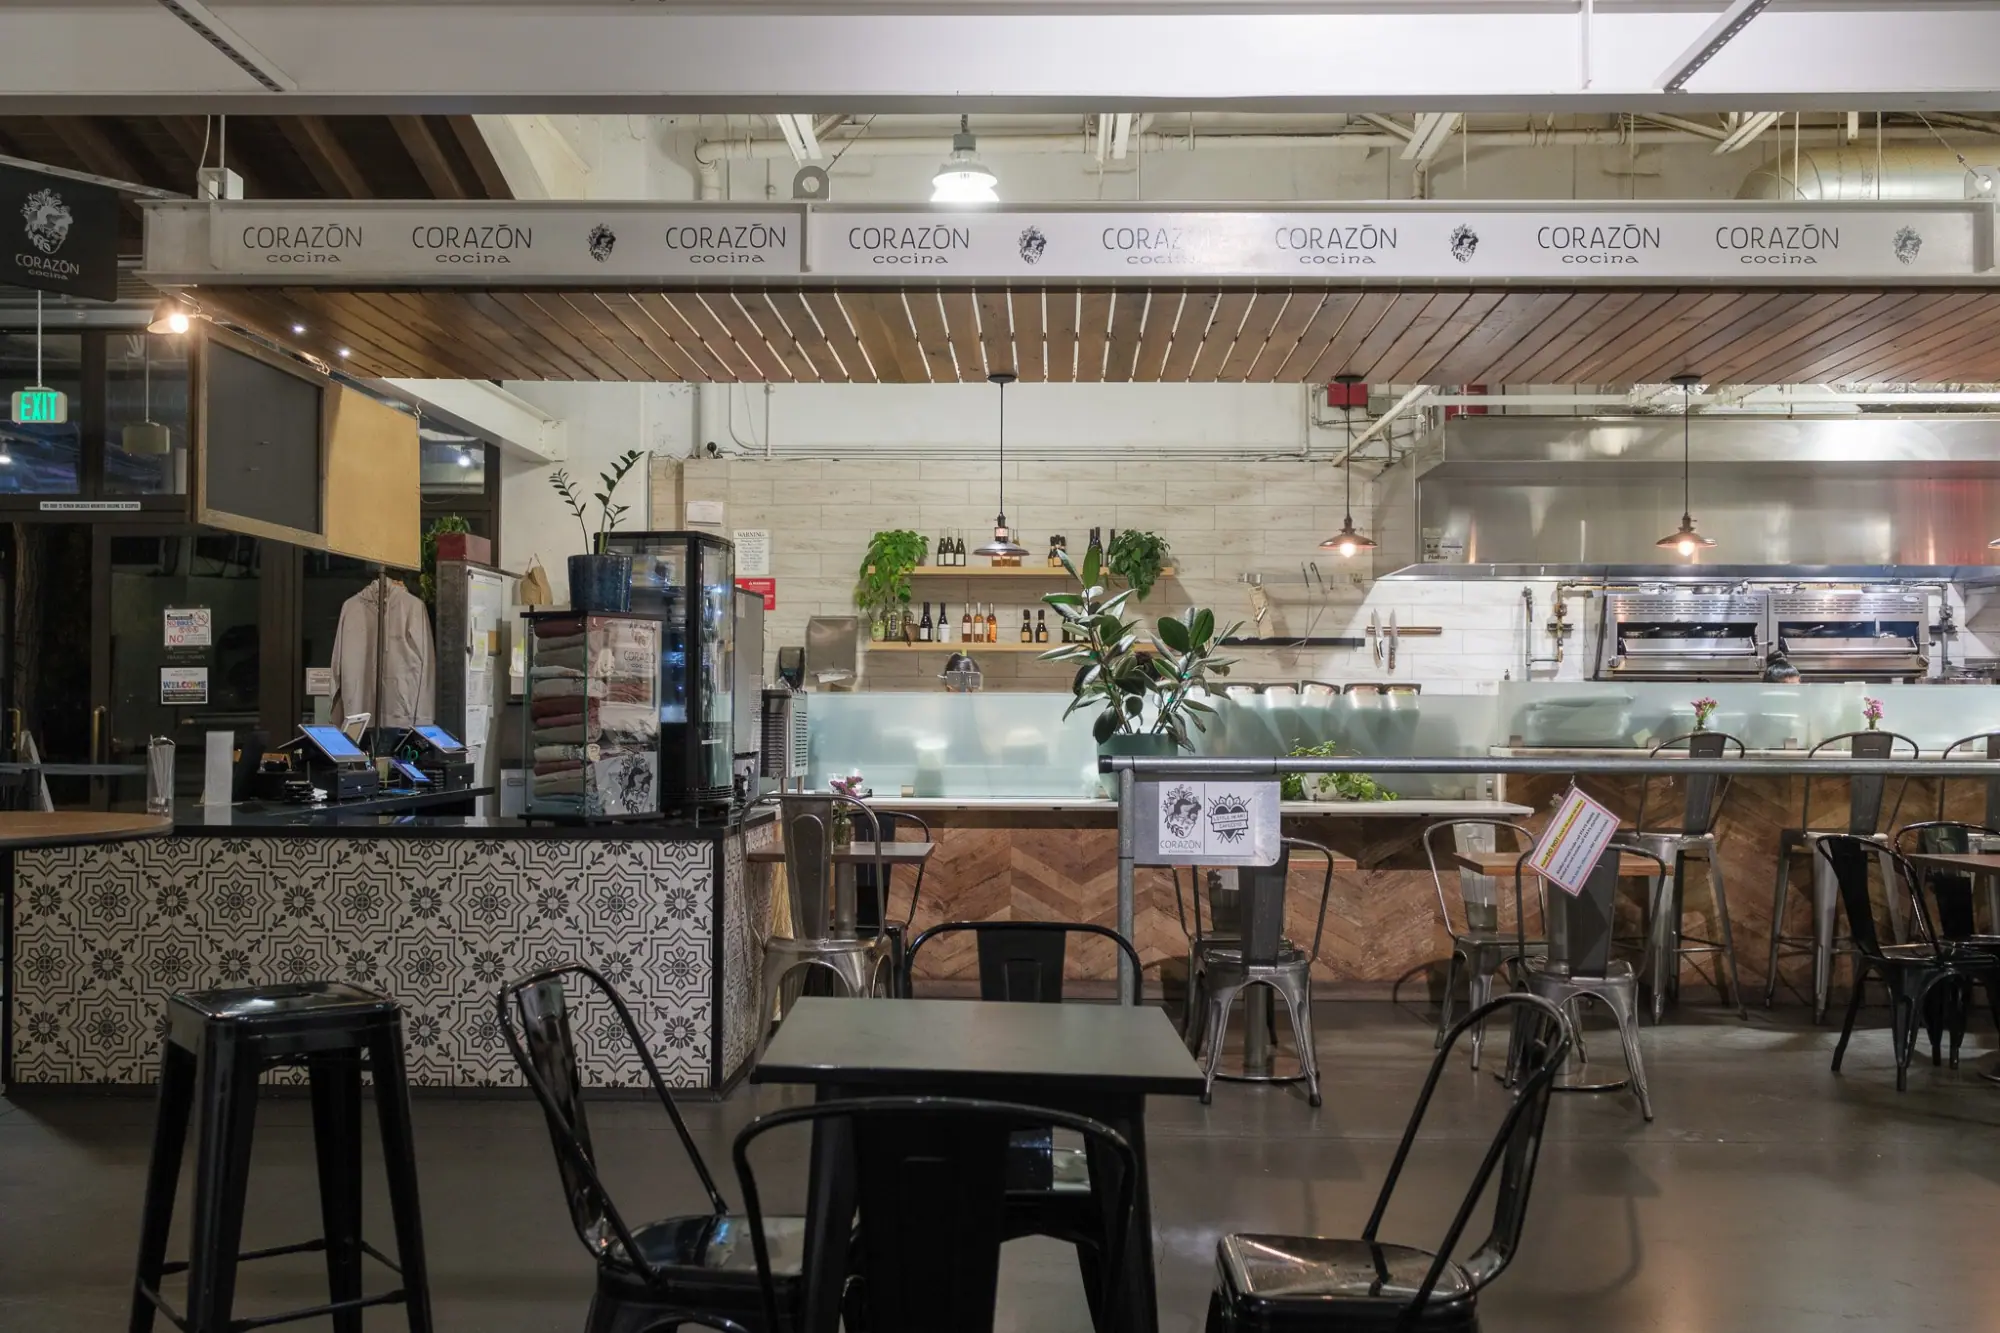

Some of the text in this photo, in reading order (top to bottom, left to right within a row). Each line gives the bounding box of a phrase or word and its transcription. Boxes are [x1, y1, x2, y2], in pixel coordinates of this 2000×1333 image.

[266, 252, 341, 263] cocina
[436, 252, 511, 263] cocina
[689, 252, 765, 264] cocina
[873, 252, 949, 264] cocina
[1300, 253, 1376, 265] cocina
[1562, 252, 1639, 264] cocina
[1741, 252, 1818, 264] cocina
[28, 269, 69, 280] cocina
[21, 391, 57, 421] EXIT
[169, 635, 184, 643] NO
[163, 681, 206, 689] WELCOME
